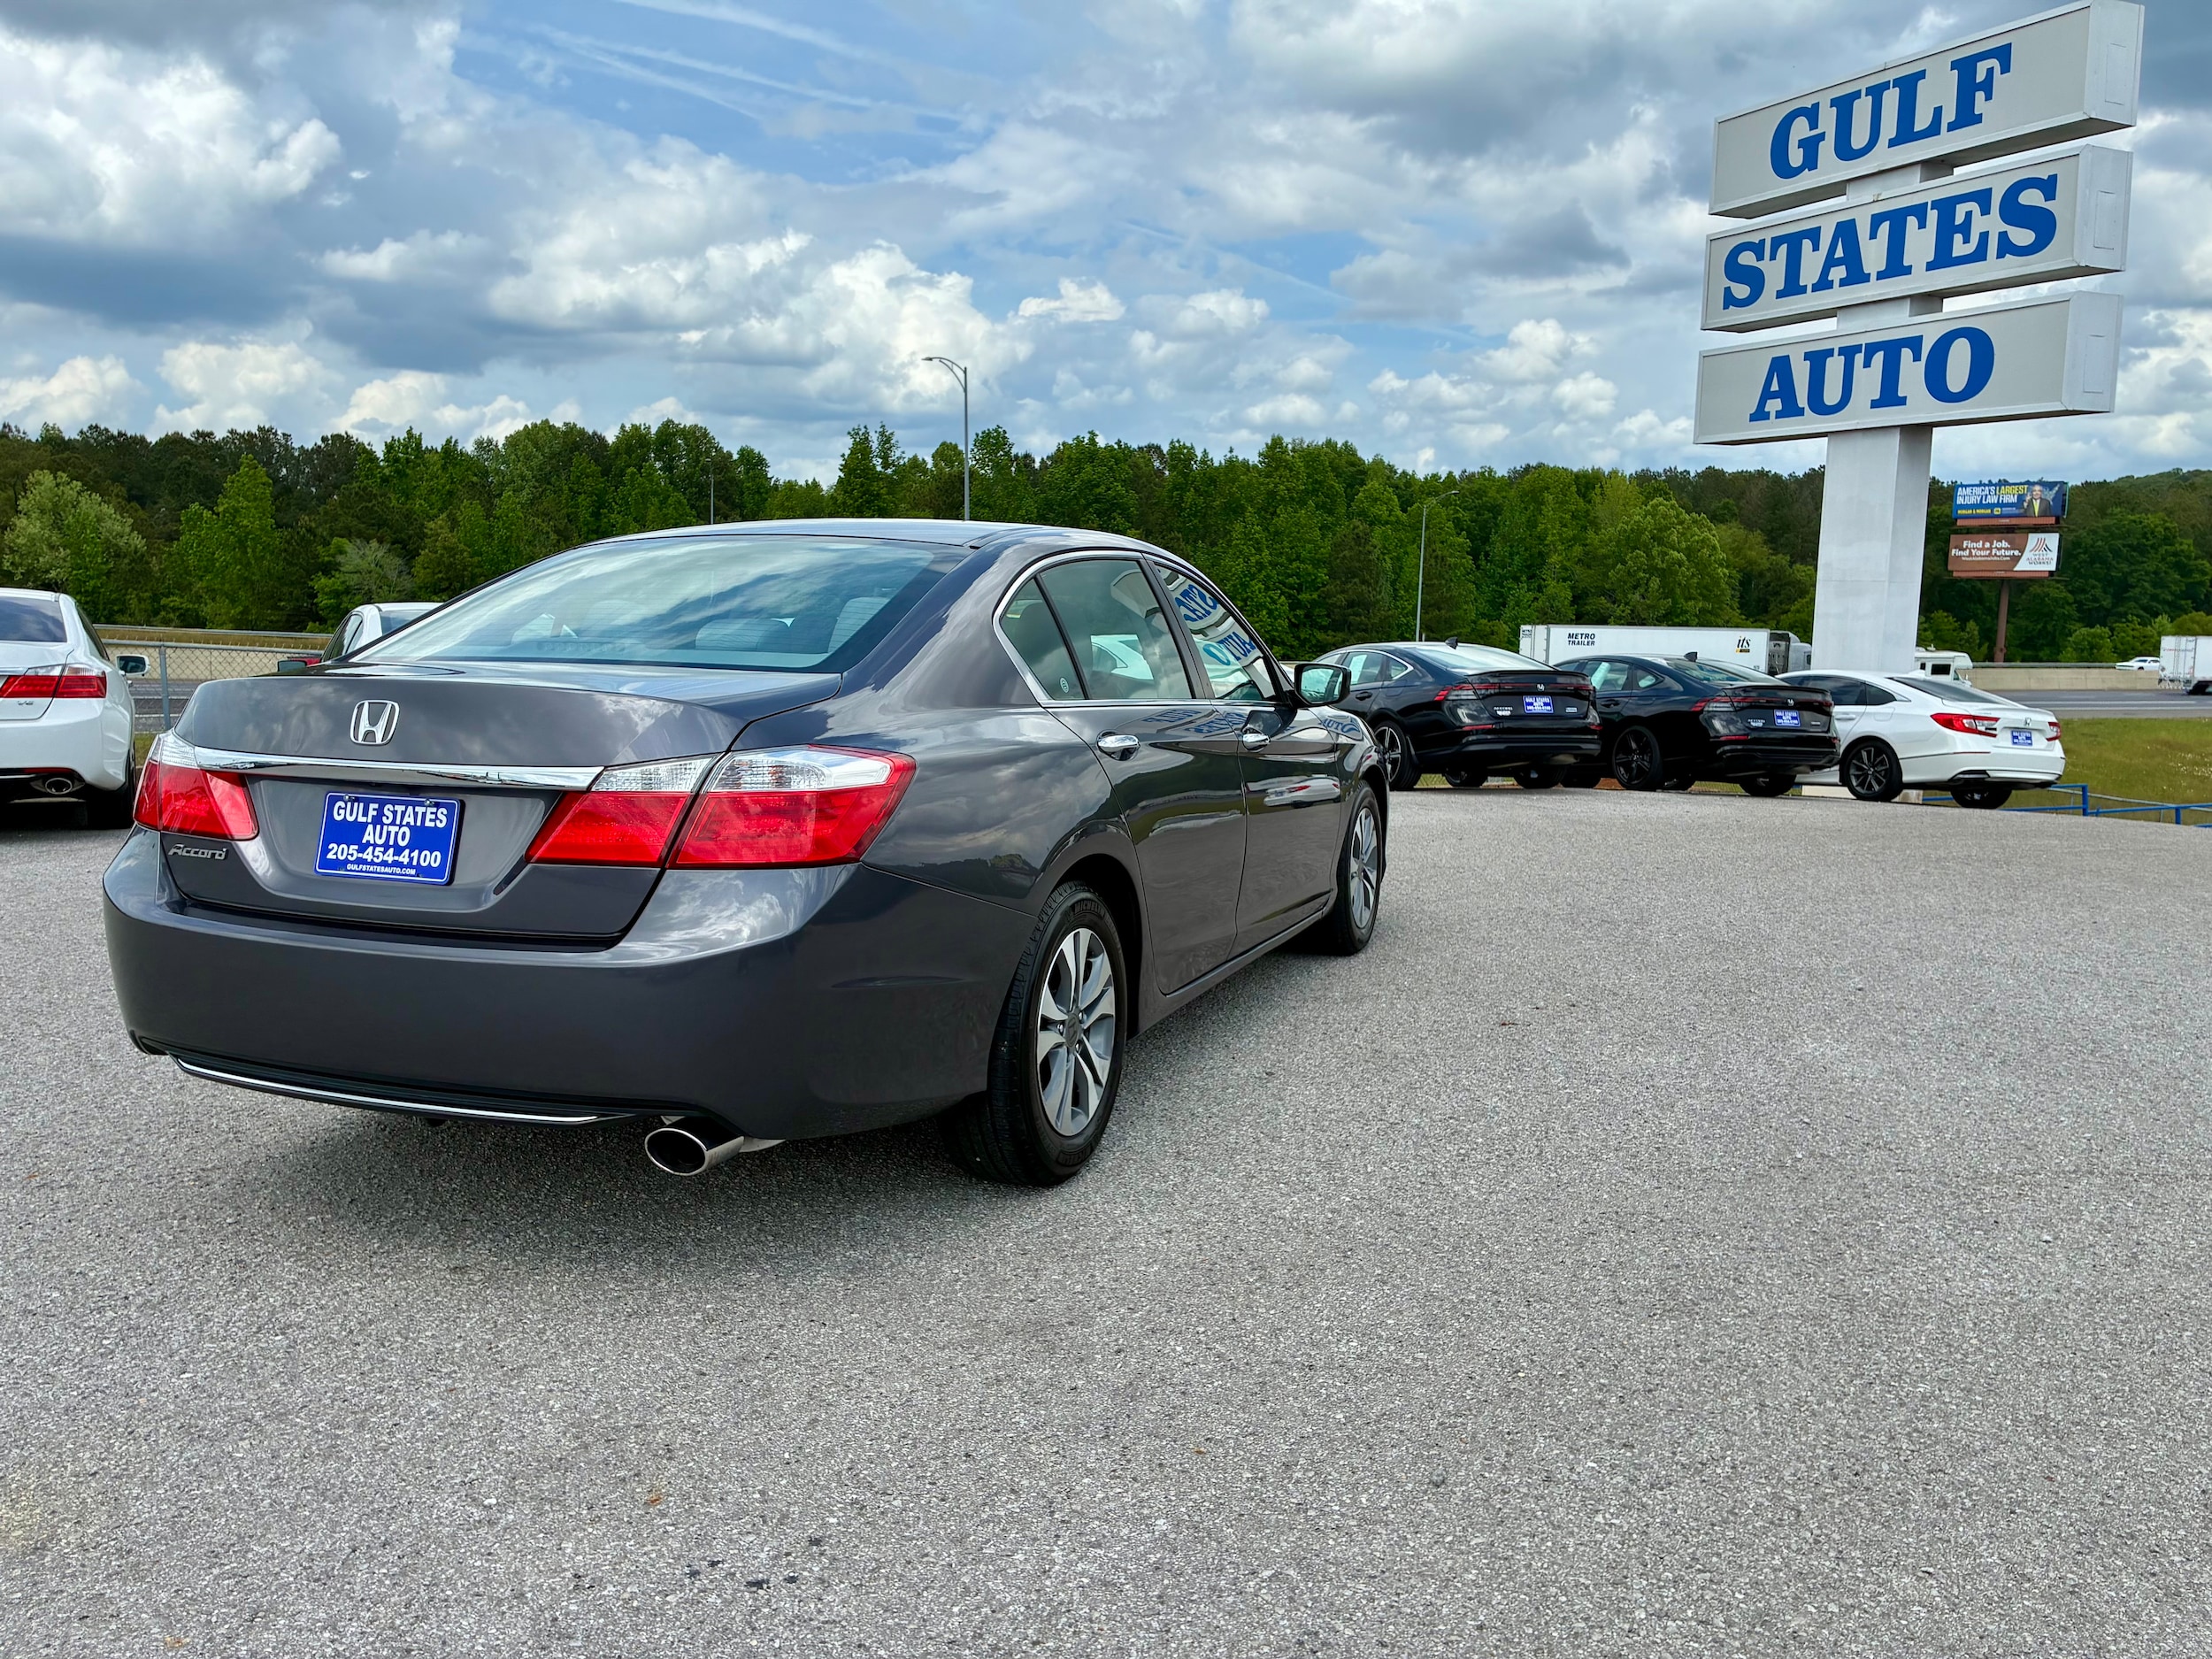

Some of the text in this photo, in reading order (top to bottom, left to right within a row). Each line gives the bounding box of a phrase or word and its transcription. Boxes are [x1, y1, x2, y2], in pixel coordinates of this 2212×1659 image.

[1770, 42, 2012, 180] GULF
[1722, 173, 2058, 311] STATES
[1748, 326, 1995, 423] AUTO
[1956, 494, 2018, 504] INJURY LAW FIRM
[1957, 485, 2029, 495] AMERICA'S LARGEST
[1992, 540, 2010, 549] Job.
[1737, 635, 1751, 649] its
[333, 801, 448, 828] GULF STATES
[362, 824, 411, 847] AUTO
[167, 843, 227, 860] Accord
[326, 842, 442, 868] 205-454-4100
[346, 864, 416, 875] GULFSTATESAUTO.COM
